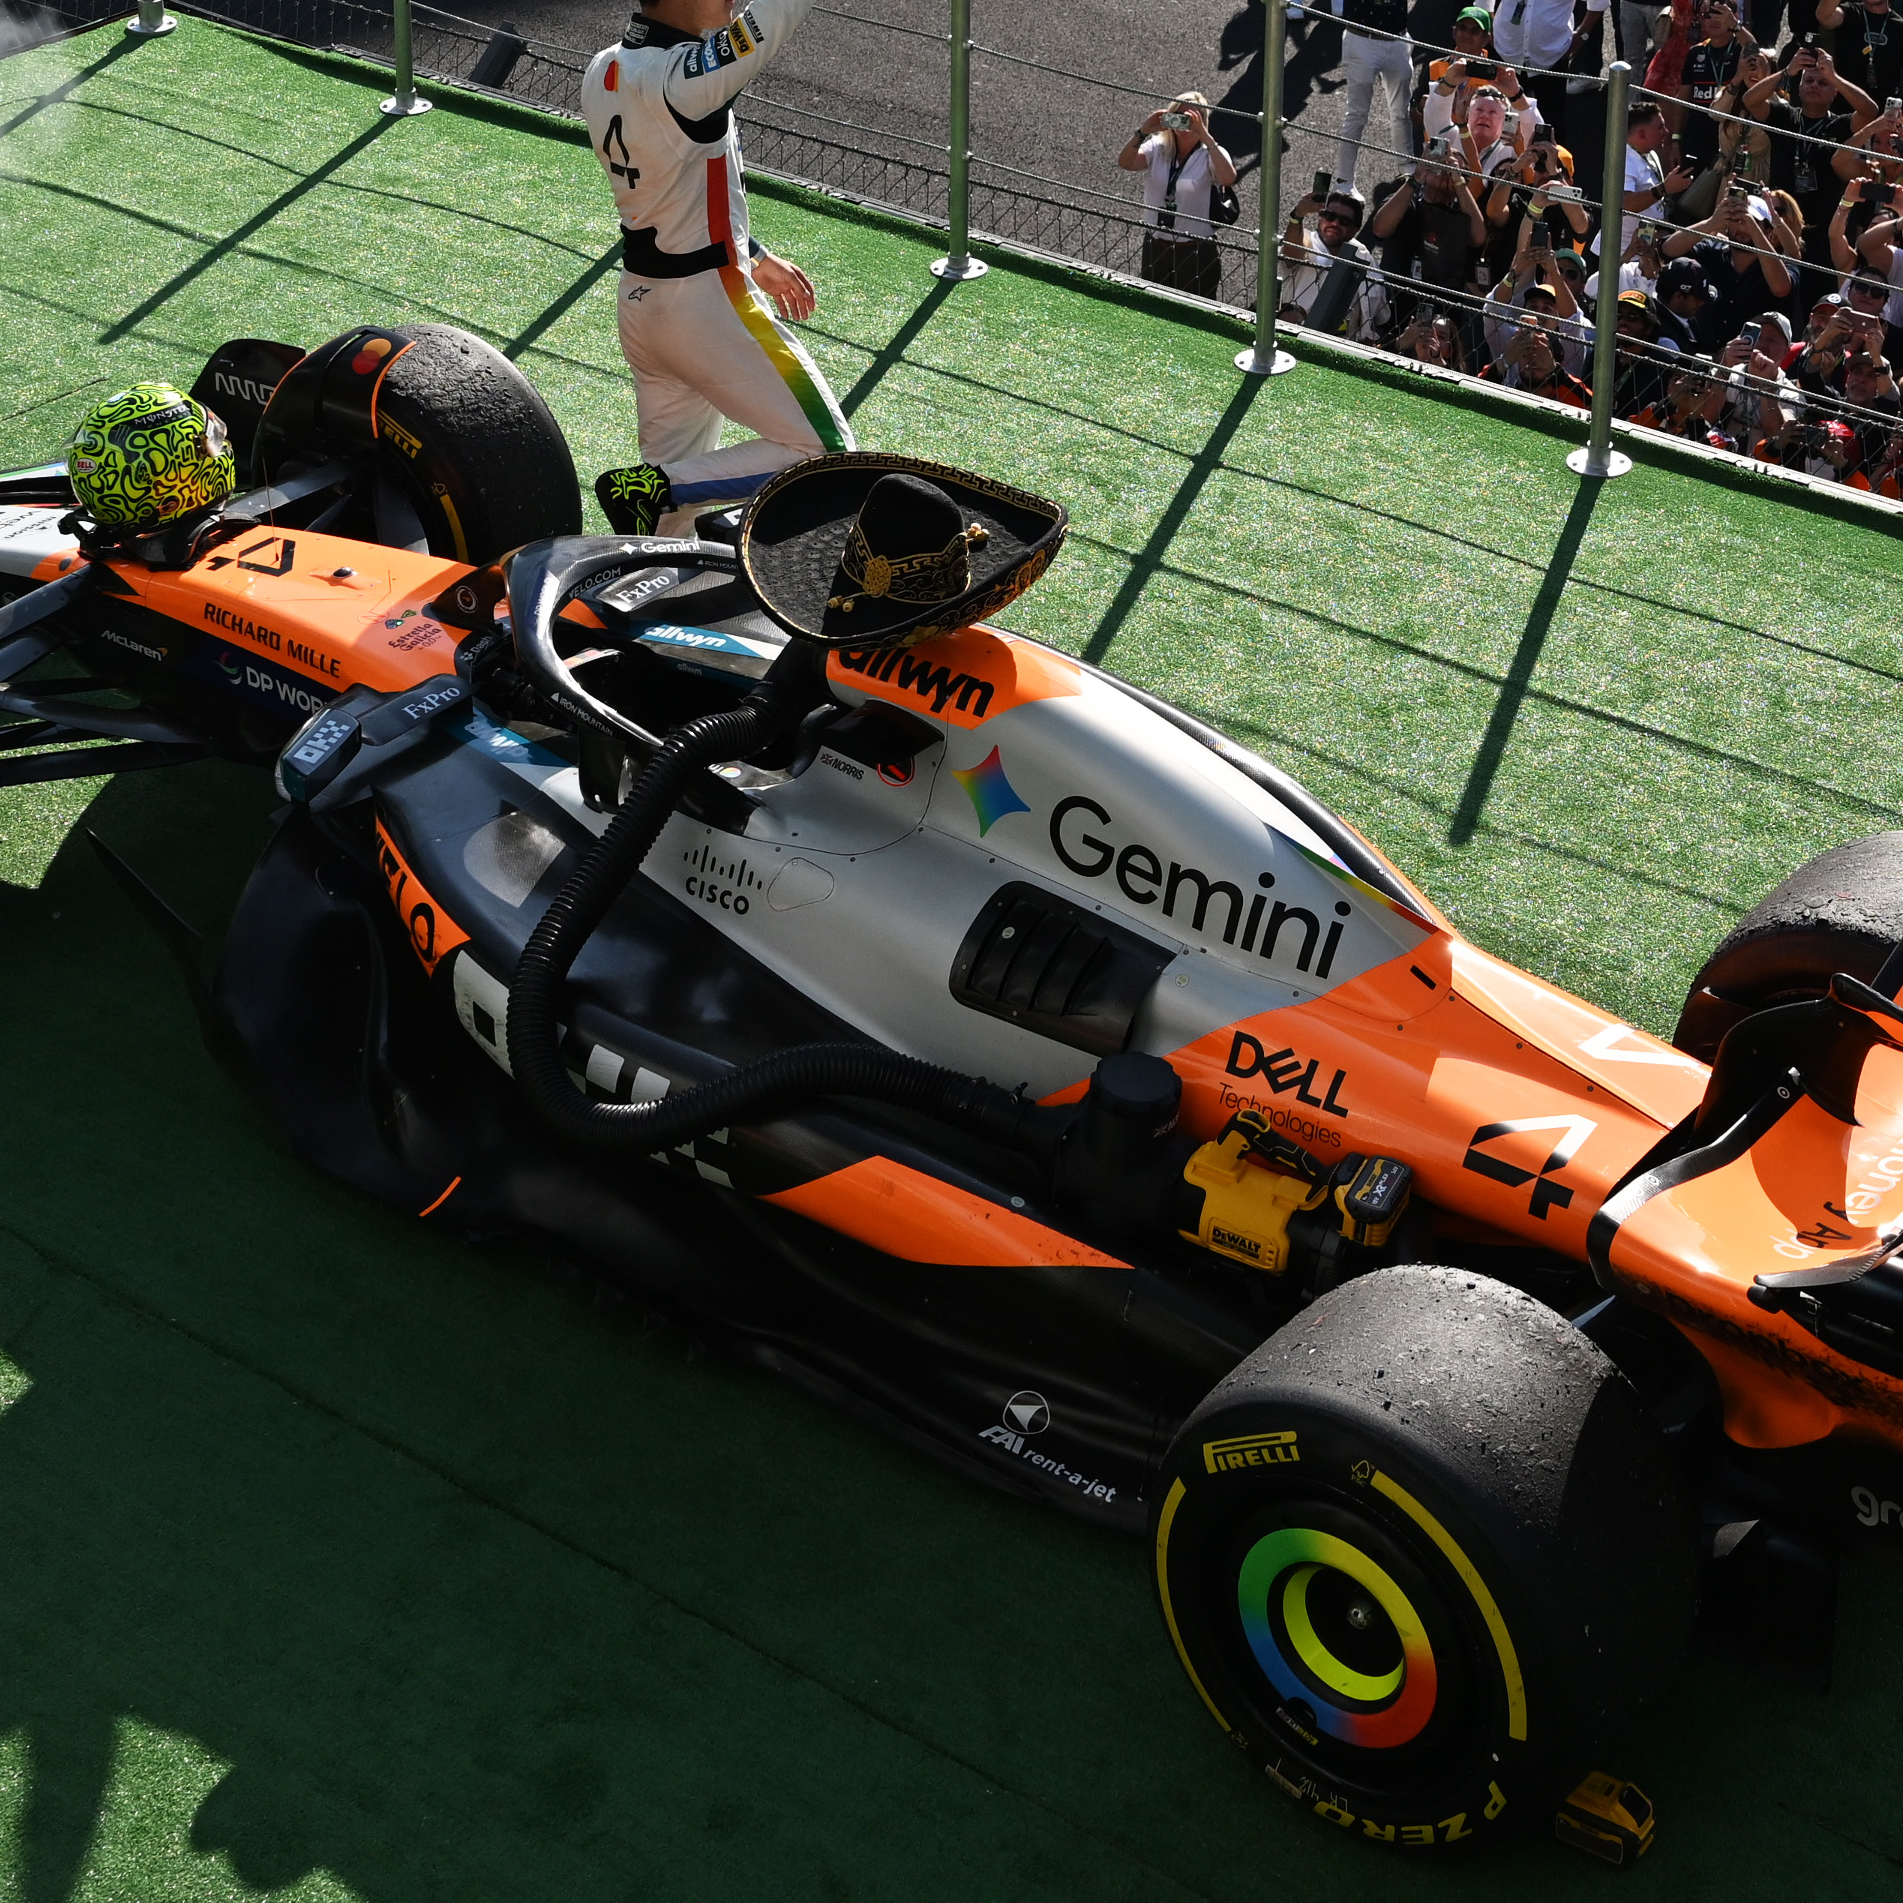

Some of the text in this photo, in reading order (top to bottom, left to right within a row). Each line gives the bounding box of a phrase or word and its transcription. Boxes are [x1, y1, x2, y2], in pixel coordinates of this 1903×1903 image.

[603, 114, 640, 189] 4
[641, 539, 700, 554] Gemini
[568, 565, 622, 600] VELO.COM
[615, 575, 670, 604] FxPro
[101, 630, 162, 662] McLaren
[203, 601, 342, 679] RICHARD MILLE
[388, 622, 434, 649] Estrella
[399, 627, 442, 652] Galicia
[645, 625, 727, 649] allwyn
[245, 665, 324, 716] DP WOR
[402, 686, 461, 720] FxPro
[839, 648, 996, 718] allwyn
[559, 697, 615, 737] IRON MOUNTAIN
[832, 757, 865, 780] NORRIS
[685, 875, 751, 916] CISCO
[1049, 794, 1352, 979] Gemini
[1225, 1030, 1349, 1119] DELL
[1217, 1082, 1342, 1148] Technologies
[1202, 1430, 1301, 1474] PIRELLI
[1022, 1447, 1117, 1504] rent-a-jet
[1313, 1800, 1473, 1846] ZERO
